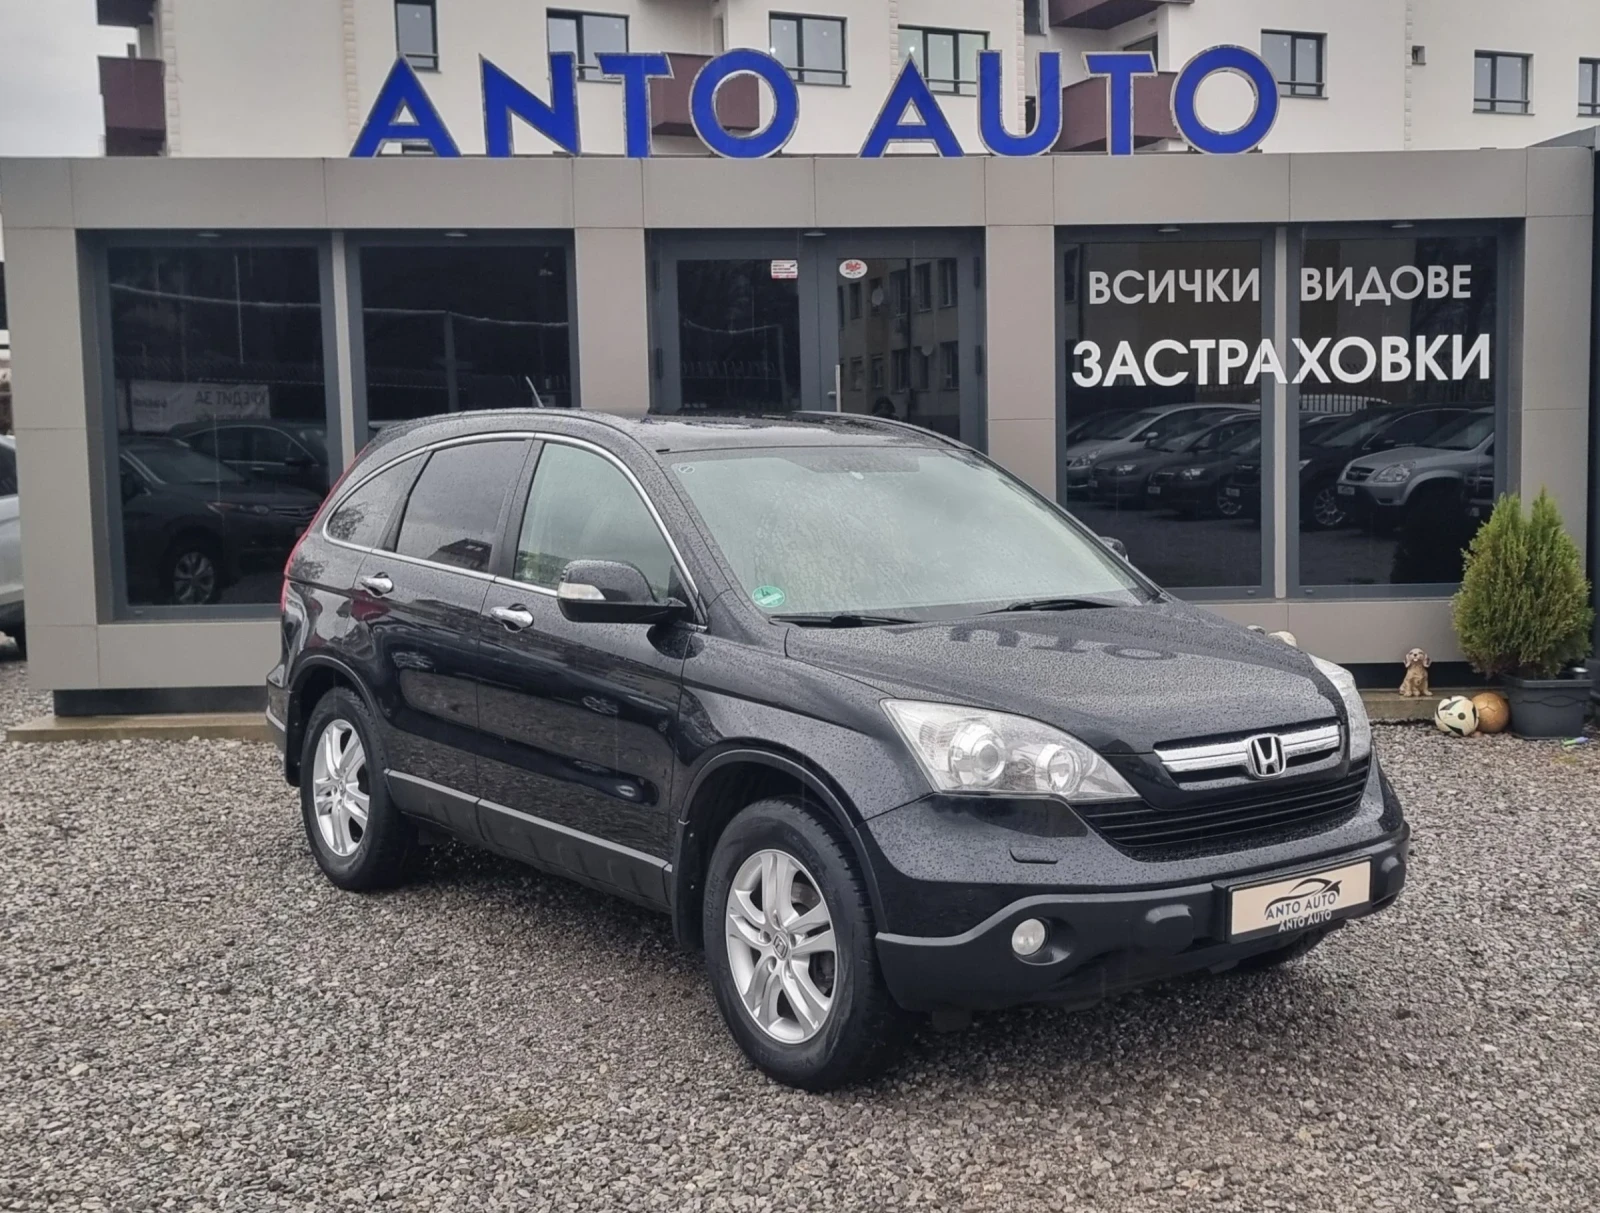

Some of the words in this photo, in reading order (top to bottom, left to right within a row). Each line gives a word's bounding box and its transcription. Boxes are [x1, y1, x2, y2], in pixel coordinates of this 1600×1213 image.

[348, 47, 800, 159] ANTO
[858, 44, 1280, 159] AUTO
[1088, 268, 1260, 304] ВСИЧКИ
[1301, 265, 1472, 307] ВИДОВЕ
[1071, 333, 1491, 387] ЗАСТРАХОВКИ
[1265, 901, 1300, 920] ANTO
[1304, 892, 1336, 911] AUTO
[1278, 917, 1306, 933] ANTO
[1307, 910, 1332, 926] AUTO
